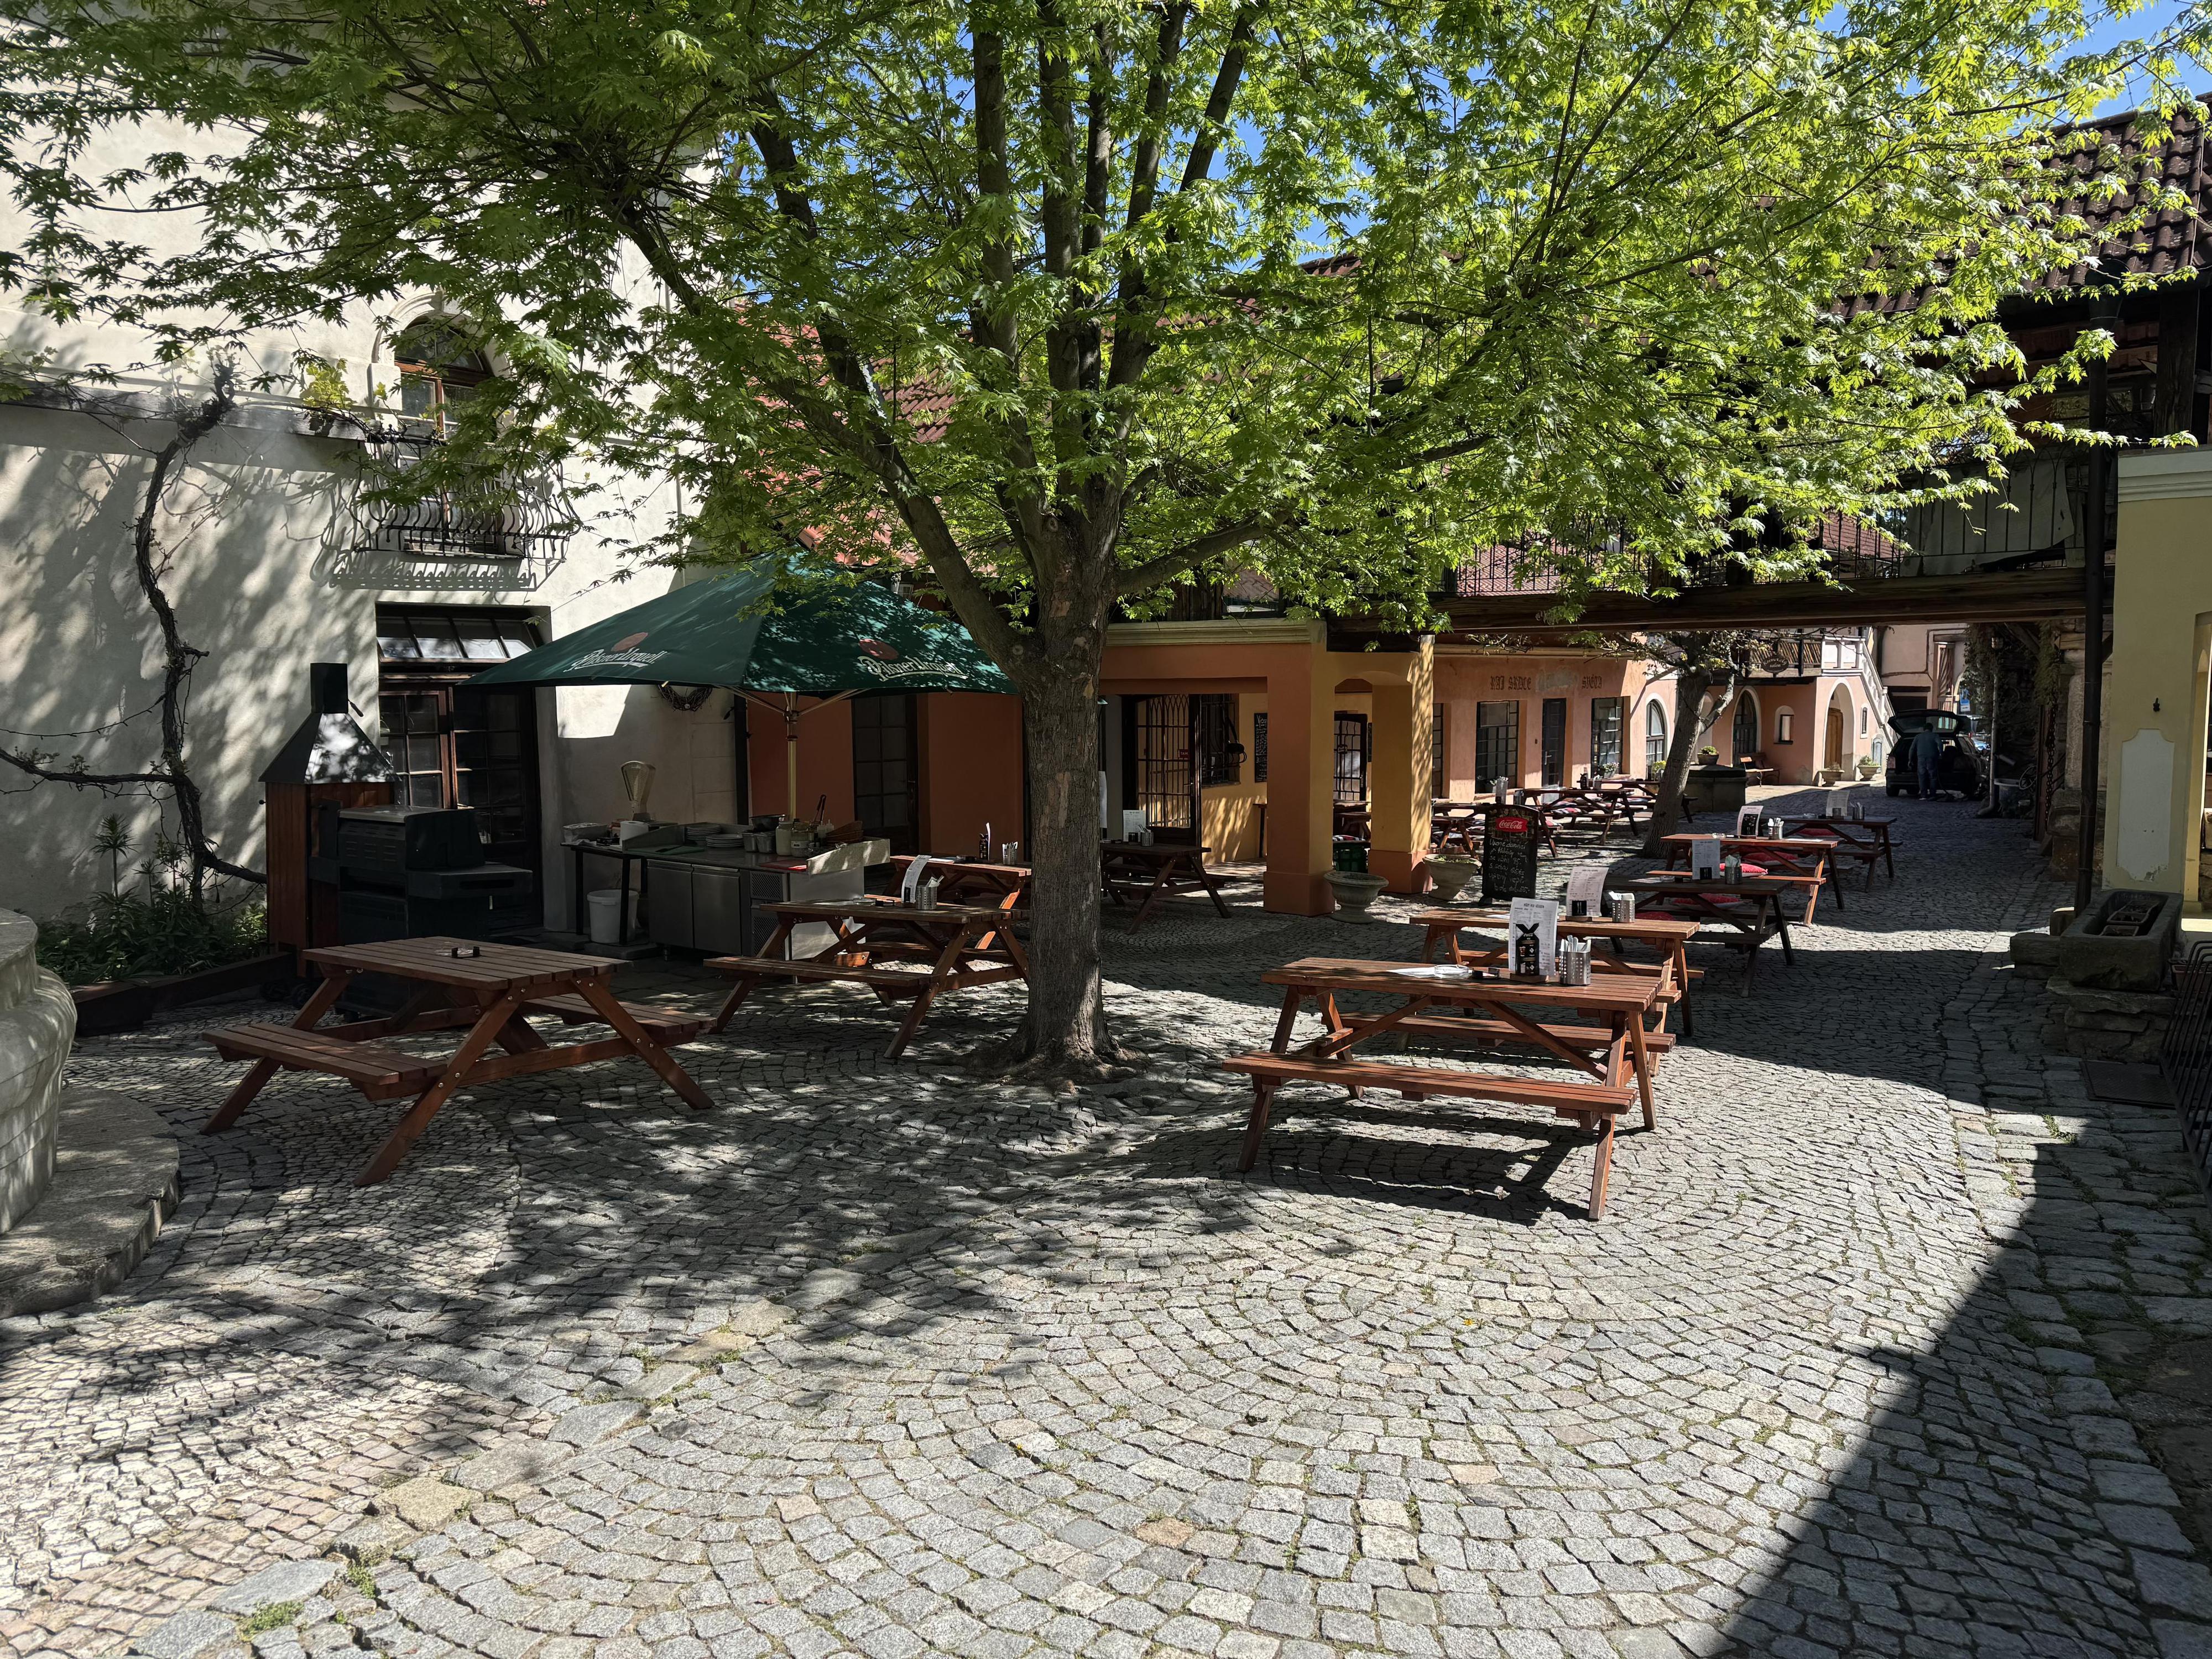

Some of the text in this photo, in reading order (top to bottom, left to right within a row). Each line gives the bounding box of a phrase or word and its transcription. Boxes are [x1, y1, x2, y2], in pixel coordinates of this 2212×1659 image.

[563, 646, 667, 672] Pilsner Urquell
[858, 655, 965, 681] Pilsner Urquell
